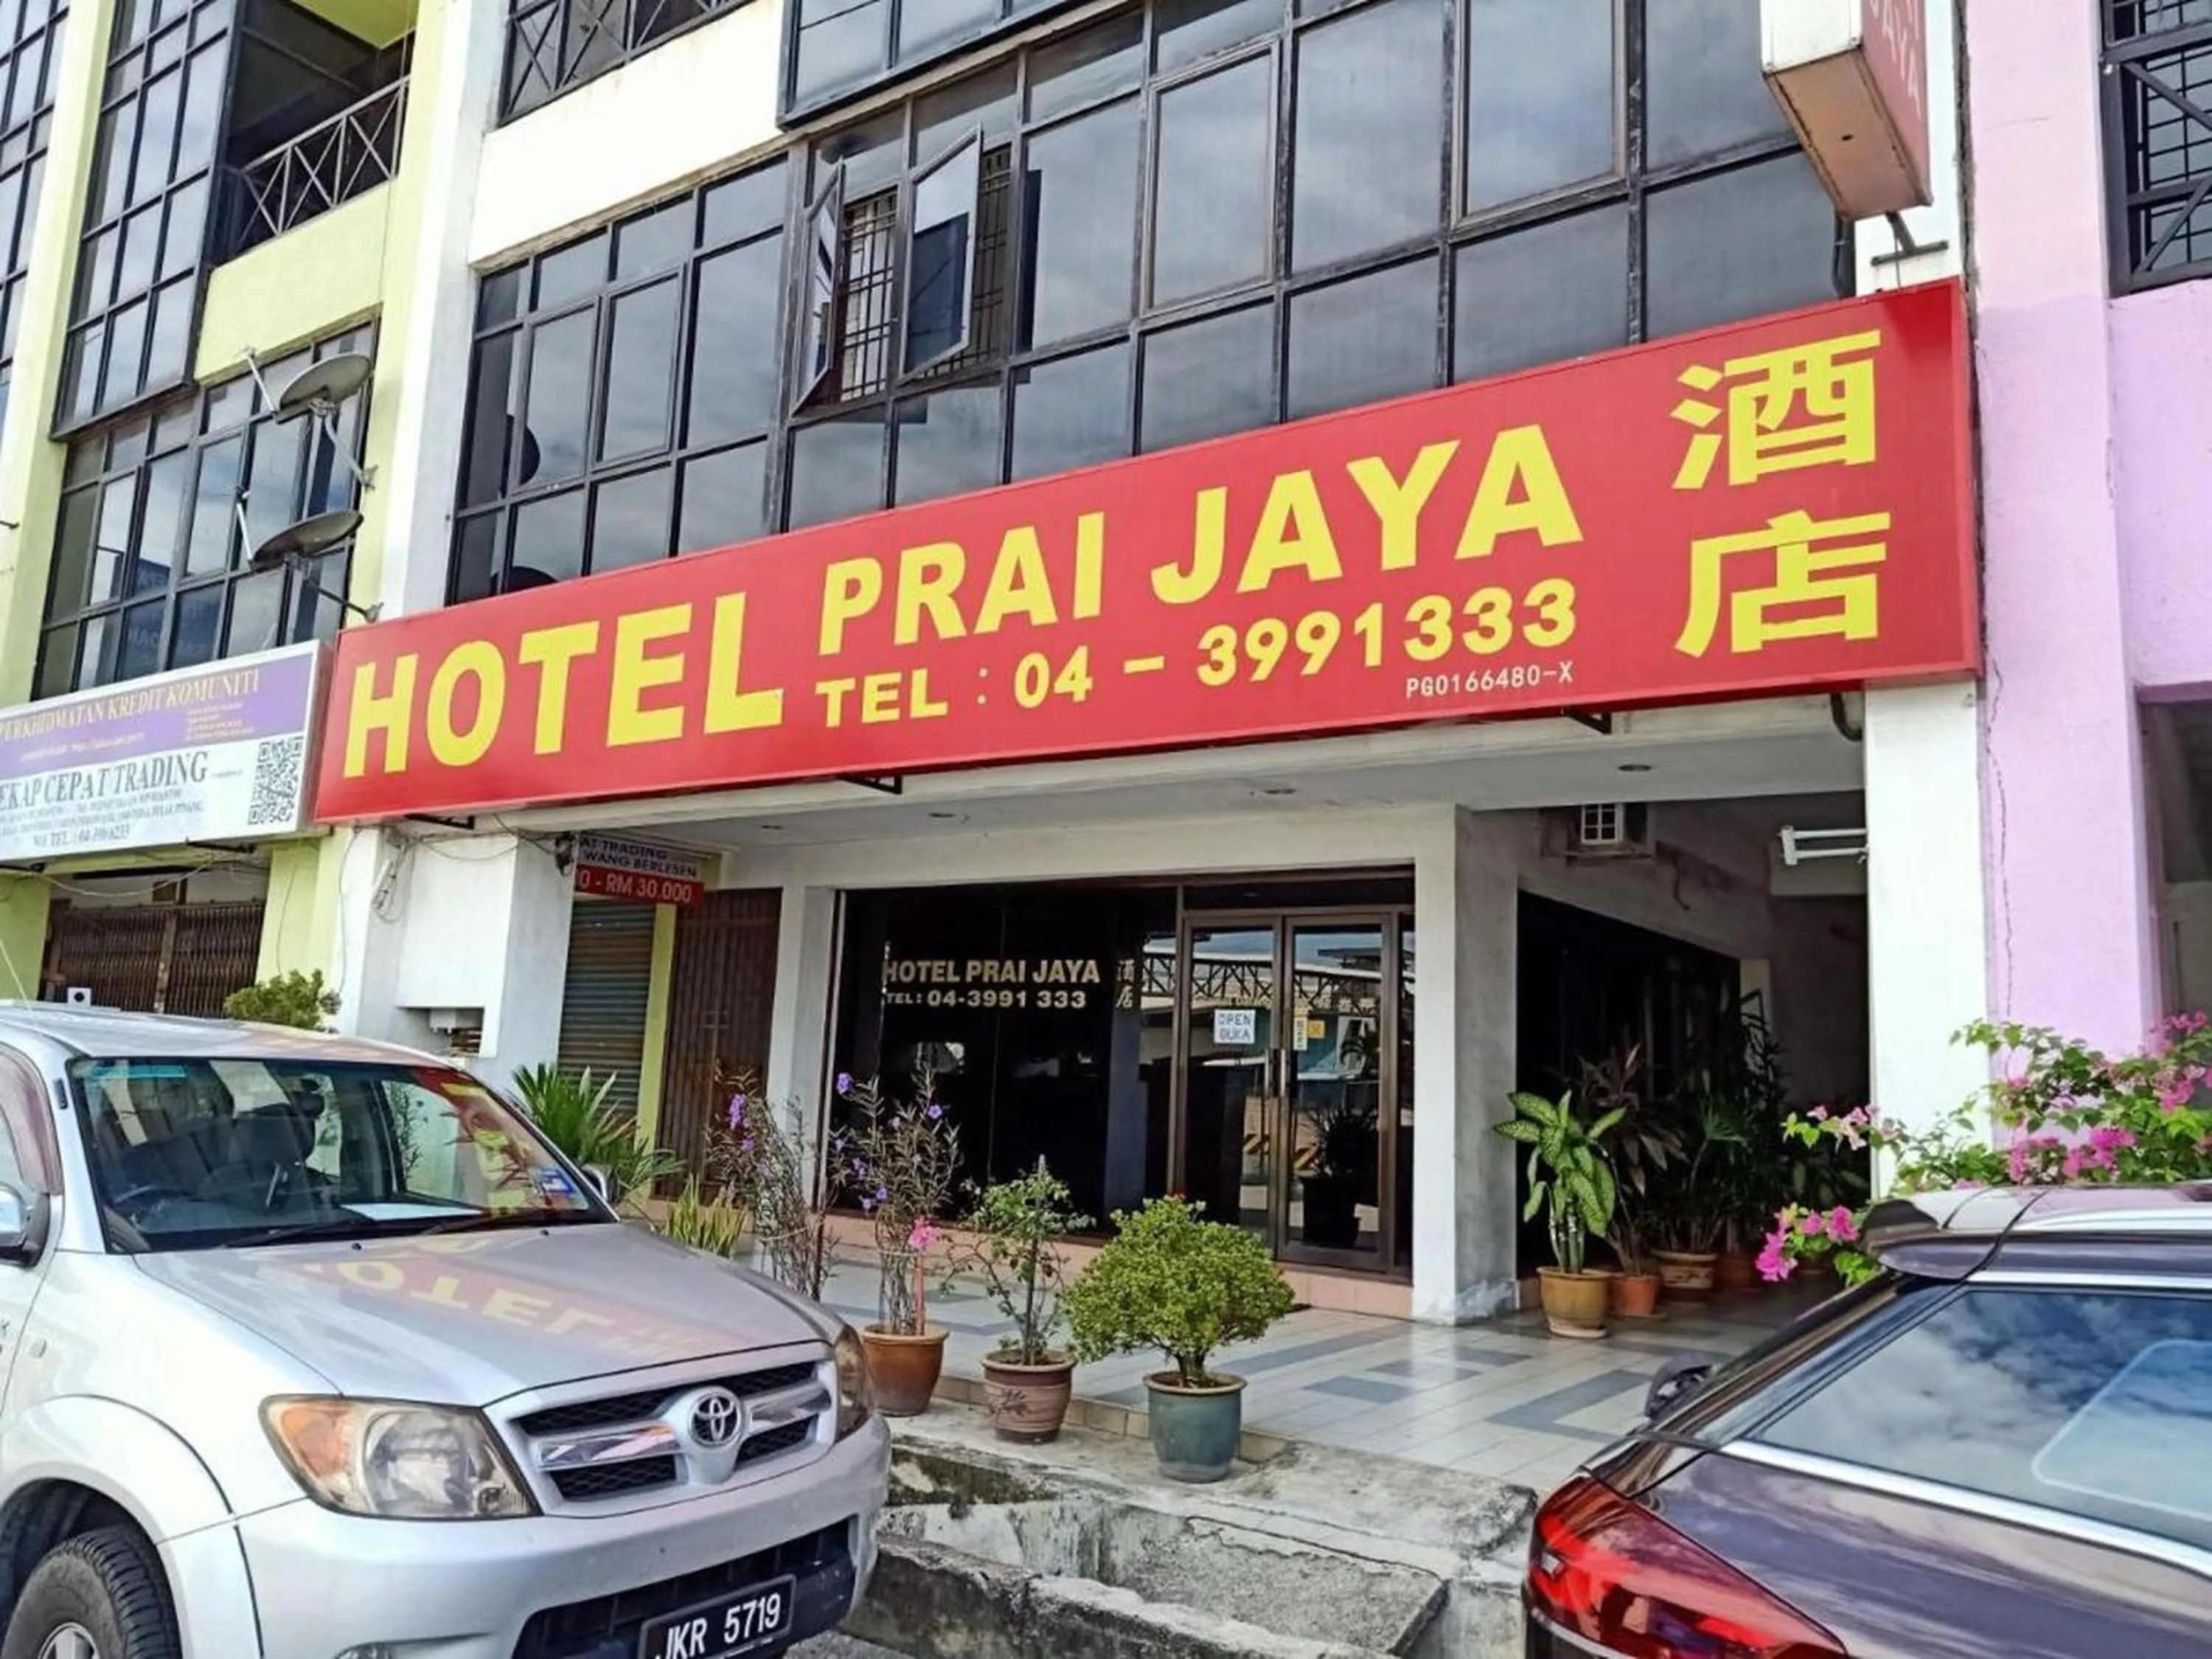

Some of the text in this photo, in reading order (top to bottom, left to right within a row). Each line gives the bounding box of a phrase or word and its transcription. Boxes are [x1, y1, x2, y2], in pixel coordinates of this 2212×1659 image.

[1670, 330, 1891, 658] 酒店
[343, 424, 1584, 778] HOTEL PRAI JAYA
[1196, 578, 1576, 686] 3991333
[108, 689, 164, 720] KREDIT
[166, 669, 260, 708] KOMUNITI
[1405, 660, 1573, 699] PG0166480-X
[44, 768, 110, 804] CEPAT
[114, 751, 209, 795] TRADING
[583, 848, 697, 877] WANG BERLESEN
[600, 840, 668, 860] TRADING
[605, 872, 633, 896] RM
[884, 959, 1101, 984] HOTEL PRAI JAYA
[927, 990, 1026, 1008] 04-3991
[1037, 990, 1087, 1009] 333
[656, 1592, 781, 1659] JKR 5719
